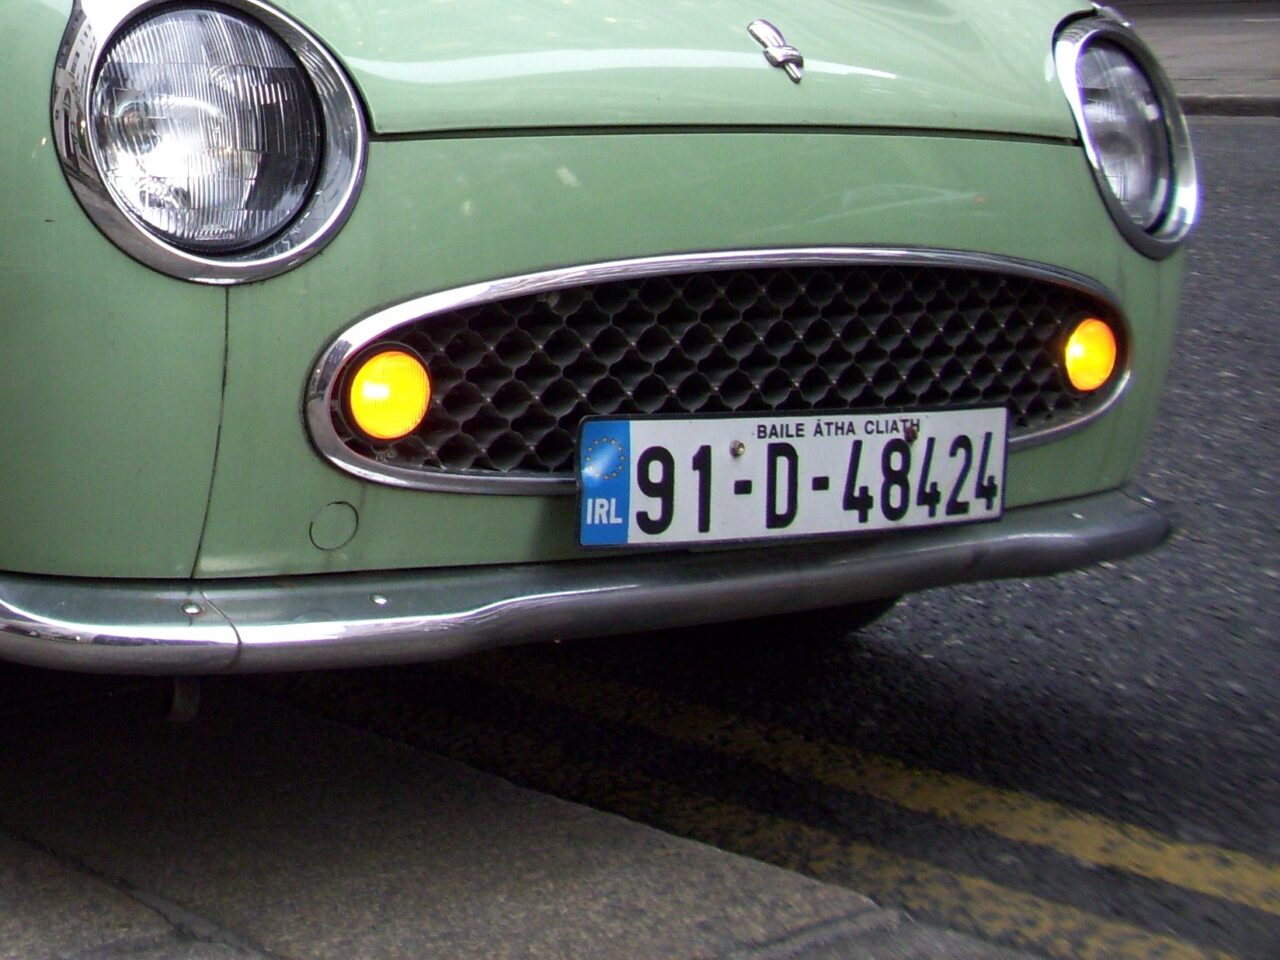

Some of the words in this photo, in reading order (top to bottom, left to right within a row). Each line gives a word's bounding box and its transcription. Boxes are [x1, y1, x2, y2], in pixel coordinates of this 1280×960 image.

[756, 423, 805, 439] BAILE
[813, 418, 856, 437] ÁTHA
[864, 418, 920, 436] CLIATH
[635, 431, 999, 536] 91-D-48424
[586, 497, 623, 526] IRL
